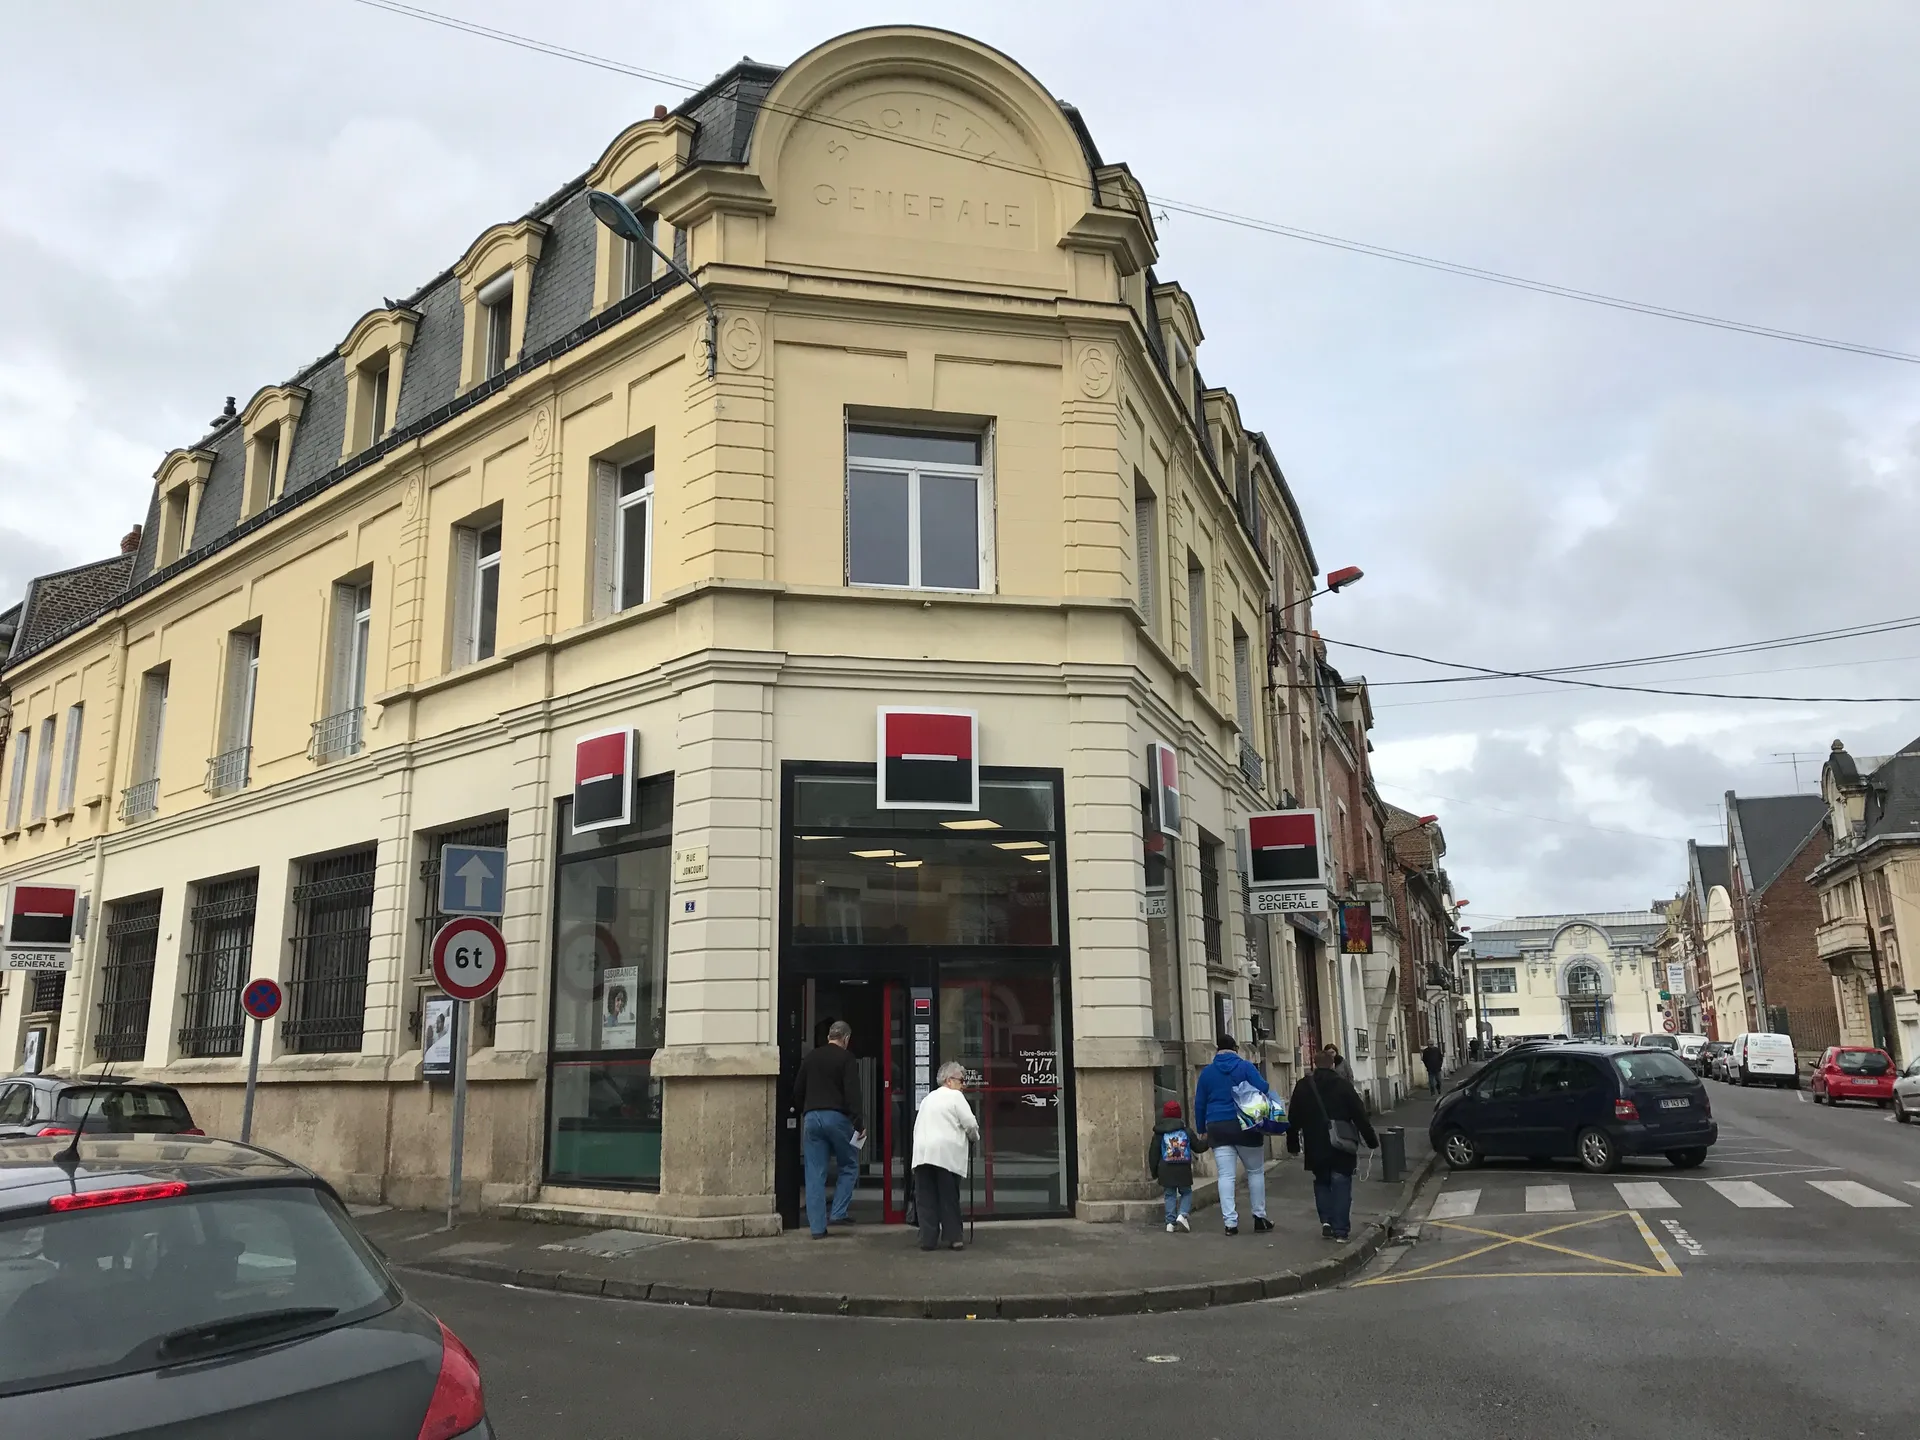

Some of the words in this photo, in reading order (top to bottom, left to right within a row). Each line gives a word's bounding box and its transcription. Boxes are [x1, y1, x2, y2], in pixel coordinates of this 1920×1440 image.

[812, 182, 1022, 229] GENERALE
[686, 853, 696, 863] RUE
[1258, 892, 1307, 902] SOCIETE
[1258, 900, 1319, 911] GENERALE
[10, 953, 56, 961] SOCIETE
[9, 960, 65, 969] GENERALE
[1025, 1058, 1053, 1074] 7j/7
[1020, 1073, 1059, 1085] 6h-22h
